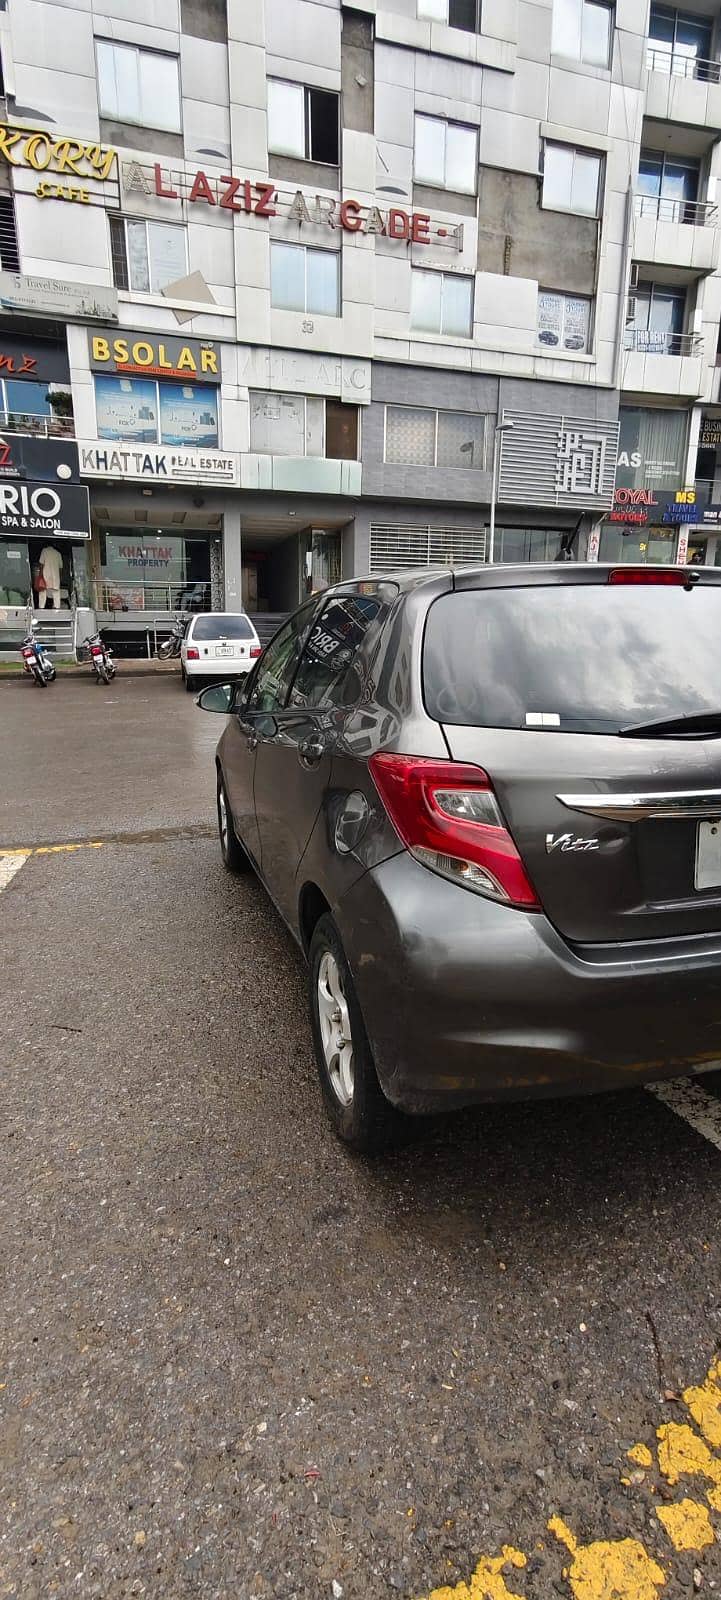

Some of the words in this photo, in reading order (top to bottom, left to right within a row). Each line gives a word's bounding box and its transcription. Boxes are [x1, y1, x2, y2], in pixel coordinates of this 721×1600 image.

[36, 181, 90, 202] CAFE
[123, 160, 178, 199] AL
[189, 171, 277, 217] AZIZ
[287, 190, 431, 244] ARCADE
[25, 278, 51, 290] Travel
[92, 336, 218, 374] BSOLAR
[82, 449, 167, 475] KHATTAK
[200, 458, 233, 470] ESTATE
[613, 487, 659, 506] OYAL
[675, 491, 696, 504] MS
[1, 515, 19, 527] SPA
[20, 517, 28, 527] &
[30, 518, 61, 529] SALON
[119, 544, 172, 560] KHATTAK
[127, 558, 169, 568] PROPERTY
